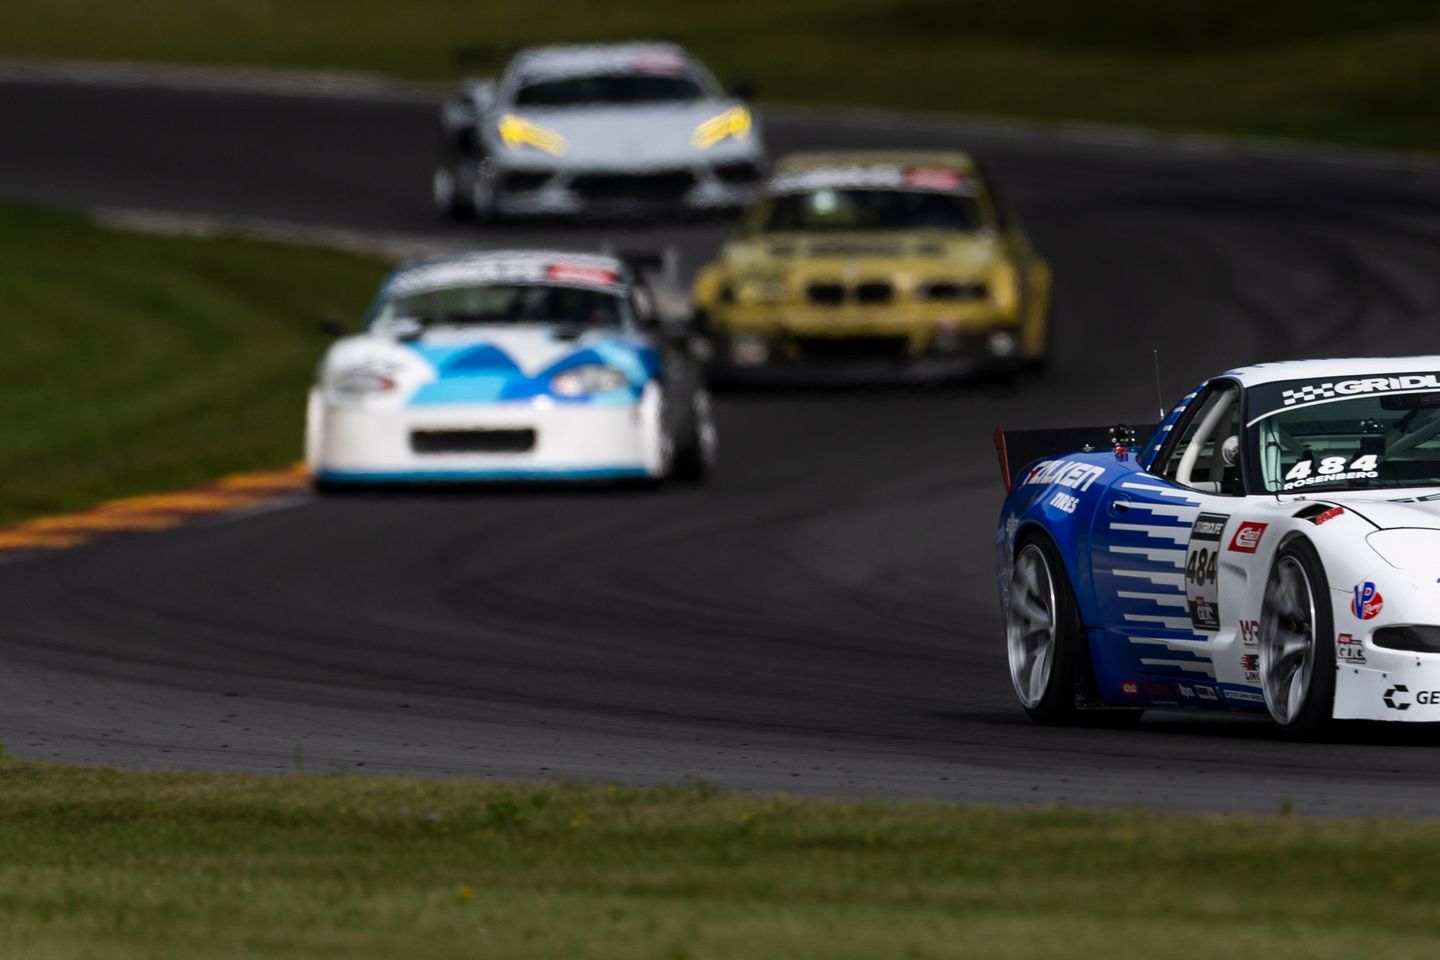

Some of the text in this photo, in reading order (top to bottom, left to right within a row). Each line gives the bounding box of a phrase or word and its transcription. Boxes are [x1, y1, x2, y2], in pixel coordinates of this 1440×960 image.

[1019, 460, 1106, 492] FALKEN
[1285, 454, 1378, 480] 484
[1283, 471, 1379, 490] ROSENBERG
[1049, 491, 1080, 514] TIRES
[1186, 548, 1218, 586] 484
